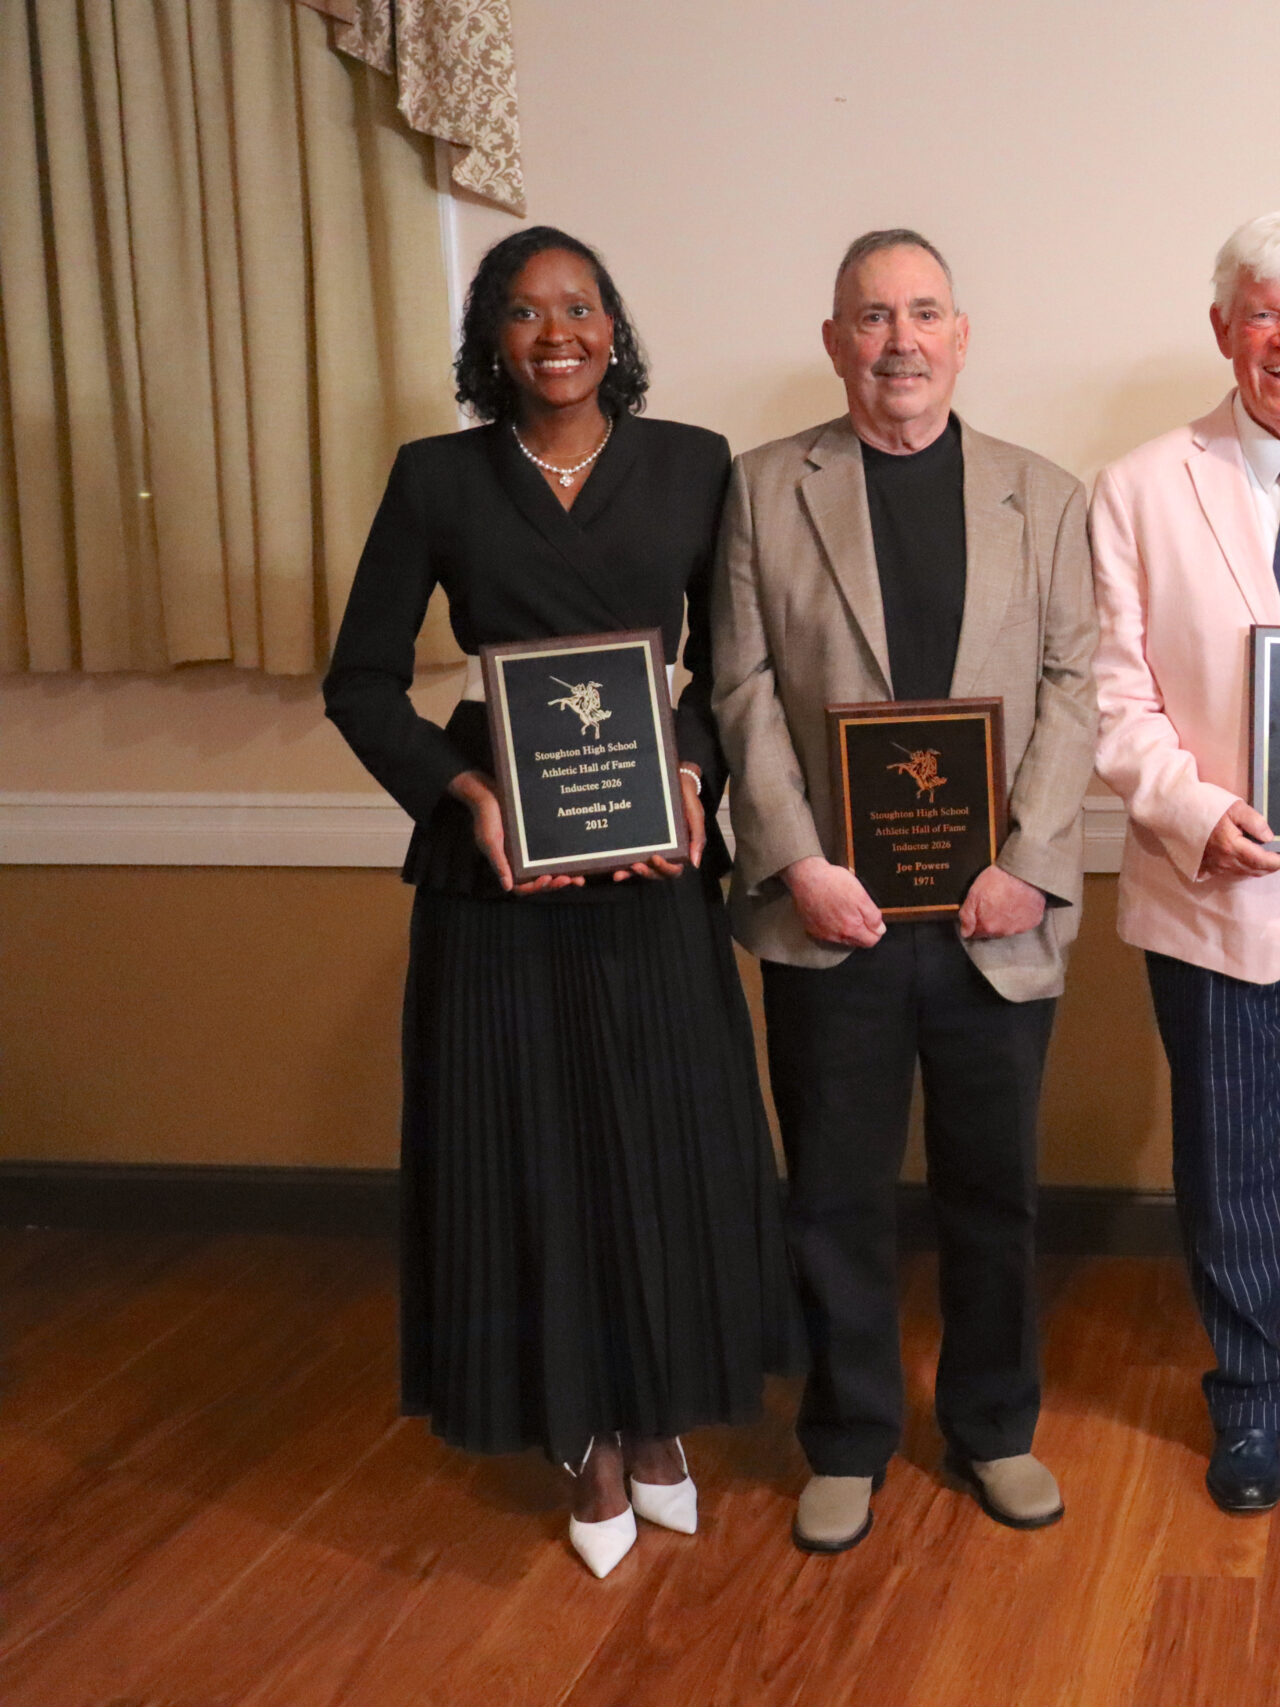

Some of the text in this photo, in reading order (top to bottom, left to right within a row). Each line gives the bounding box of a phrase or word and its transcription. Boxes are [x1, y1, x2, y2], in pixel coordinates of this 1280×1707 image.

[534, 740, 638, 761] Stoughton High School
[541, 760, 636, 778] Athletic Hall of Fame
[560, 778, 622, 794] Inductee 2026
[557, 800, 632, 817] Antonella Jade
[870, 807, 969, 820] Stoughton High School
[586, 819, 608, 830] 2012
[875, 824, 966, 836] Athletic Hall of Fame
[892, 841, 951, 852] Inductee 2026
[896, 862, 950, 873] Joe Powers
[914, 876, 934, 886] 1971
